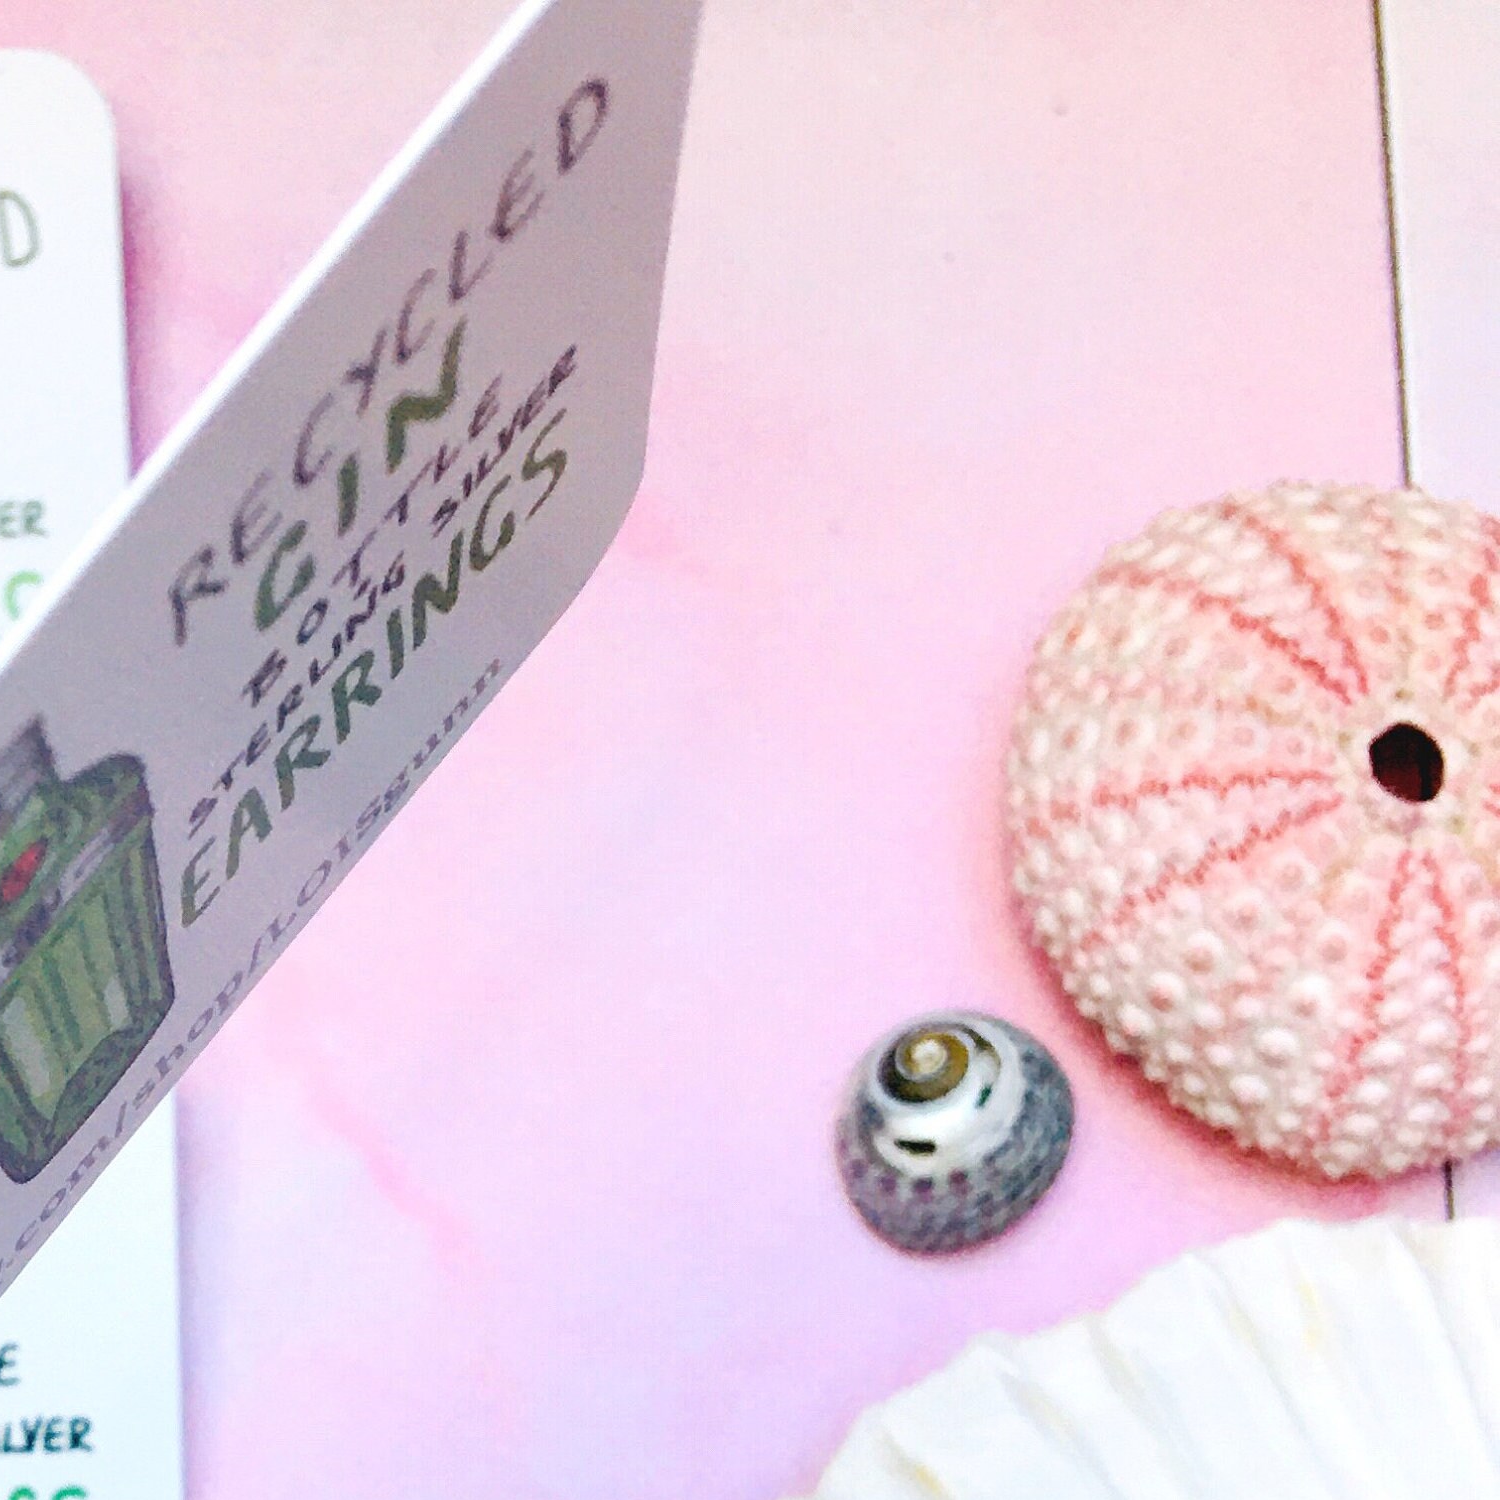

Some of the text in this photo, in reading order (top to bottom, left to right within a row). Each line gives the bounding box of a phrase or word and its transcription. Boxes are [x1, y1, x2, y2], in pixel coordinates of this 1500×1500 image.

[168, 76, 610, 646] RECYCLED
[187, 343, 578, 840] STERLING SILVER
[241, 372, 503, 708] BOTTLE
[254, 312, 468, 632] GIN
[179, 408, 569, 929] EARRINGS
